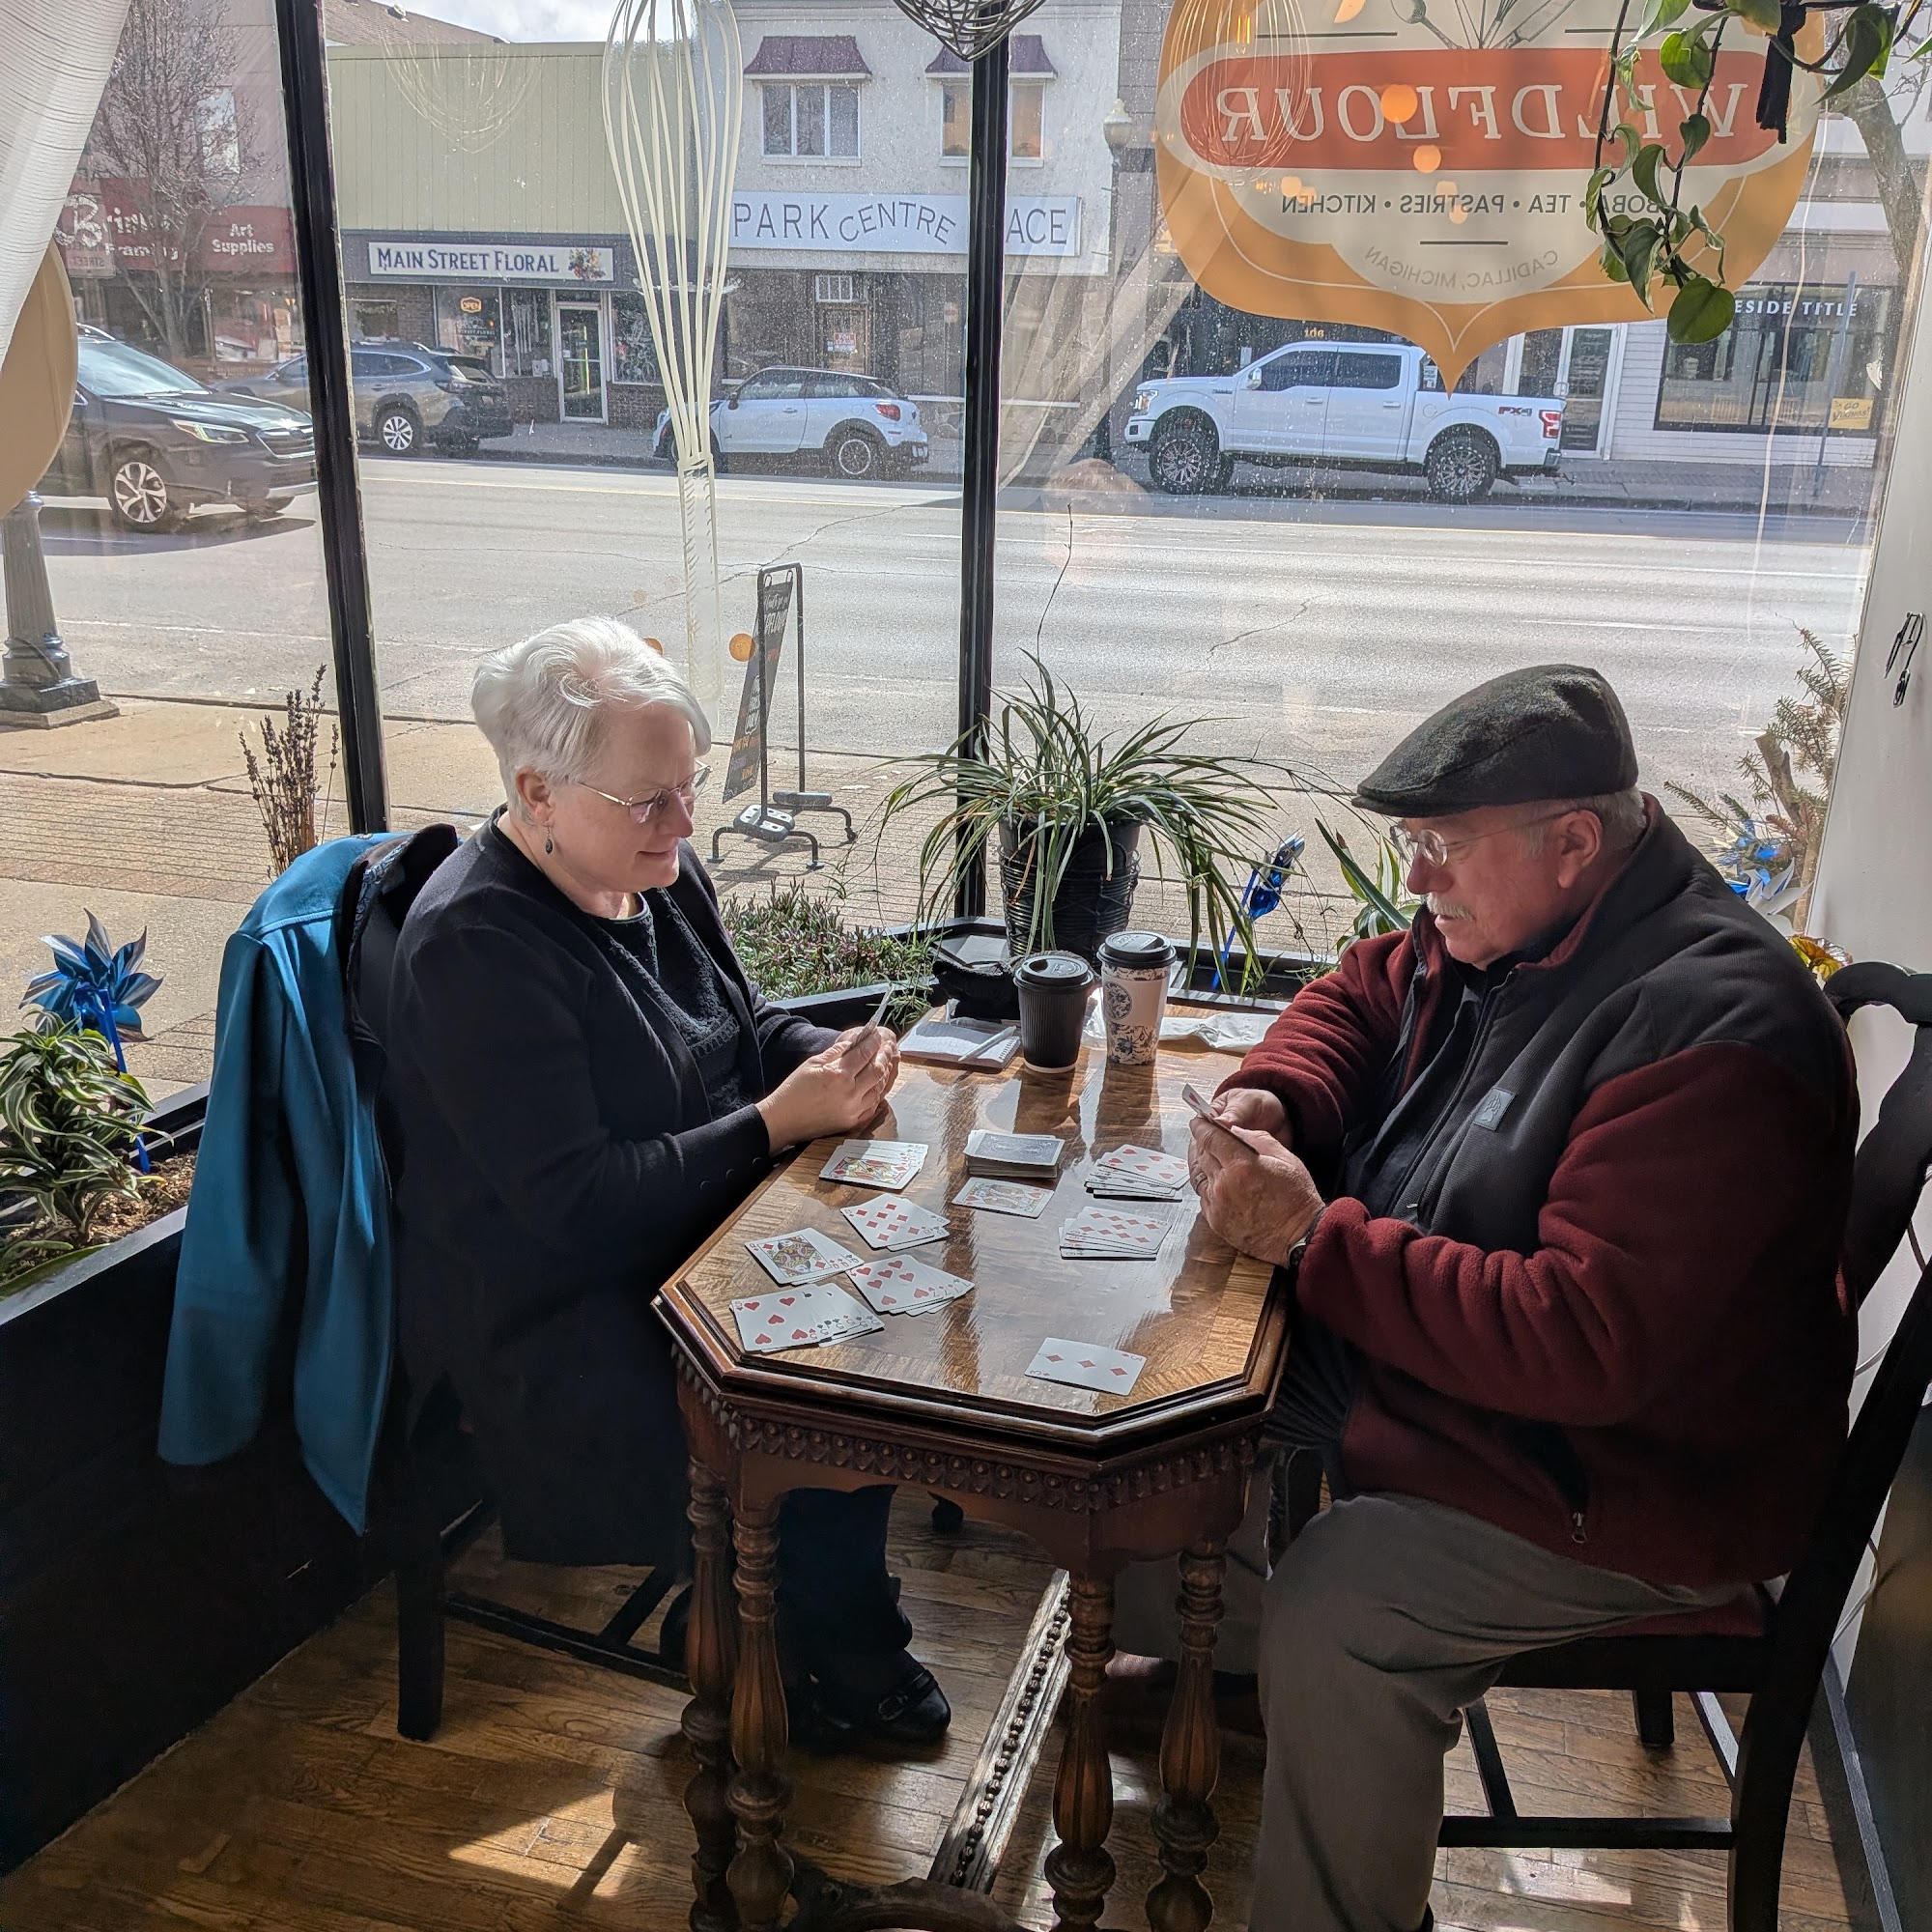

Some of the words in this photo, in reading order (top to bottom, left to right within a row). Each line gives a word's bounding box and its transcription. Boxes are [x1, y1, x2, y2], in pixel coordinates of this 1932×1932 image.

[229, 223, 254, 238] Art
[732, 203, 831, 241] PARK
[838, 201, 957, 246] CENTRE
[1006, 209, 1068, 244] ACE
[212, 239, 274, 256] Supplies
[377, 247, 424, 269] MAIN
[428, 249, 490, 270] STREET
[495, 250, 560, 273] FLORAL
[463, 300, 481, 310] OPEN
[1734, 299, 1793, 315] ESIDE
[1803, 301, 1858, 317] TITLE
[1497, 406, 1533, 416] FX4
